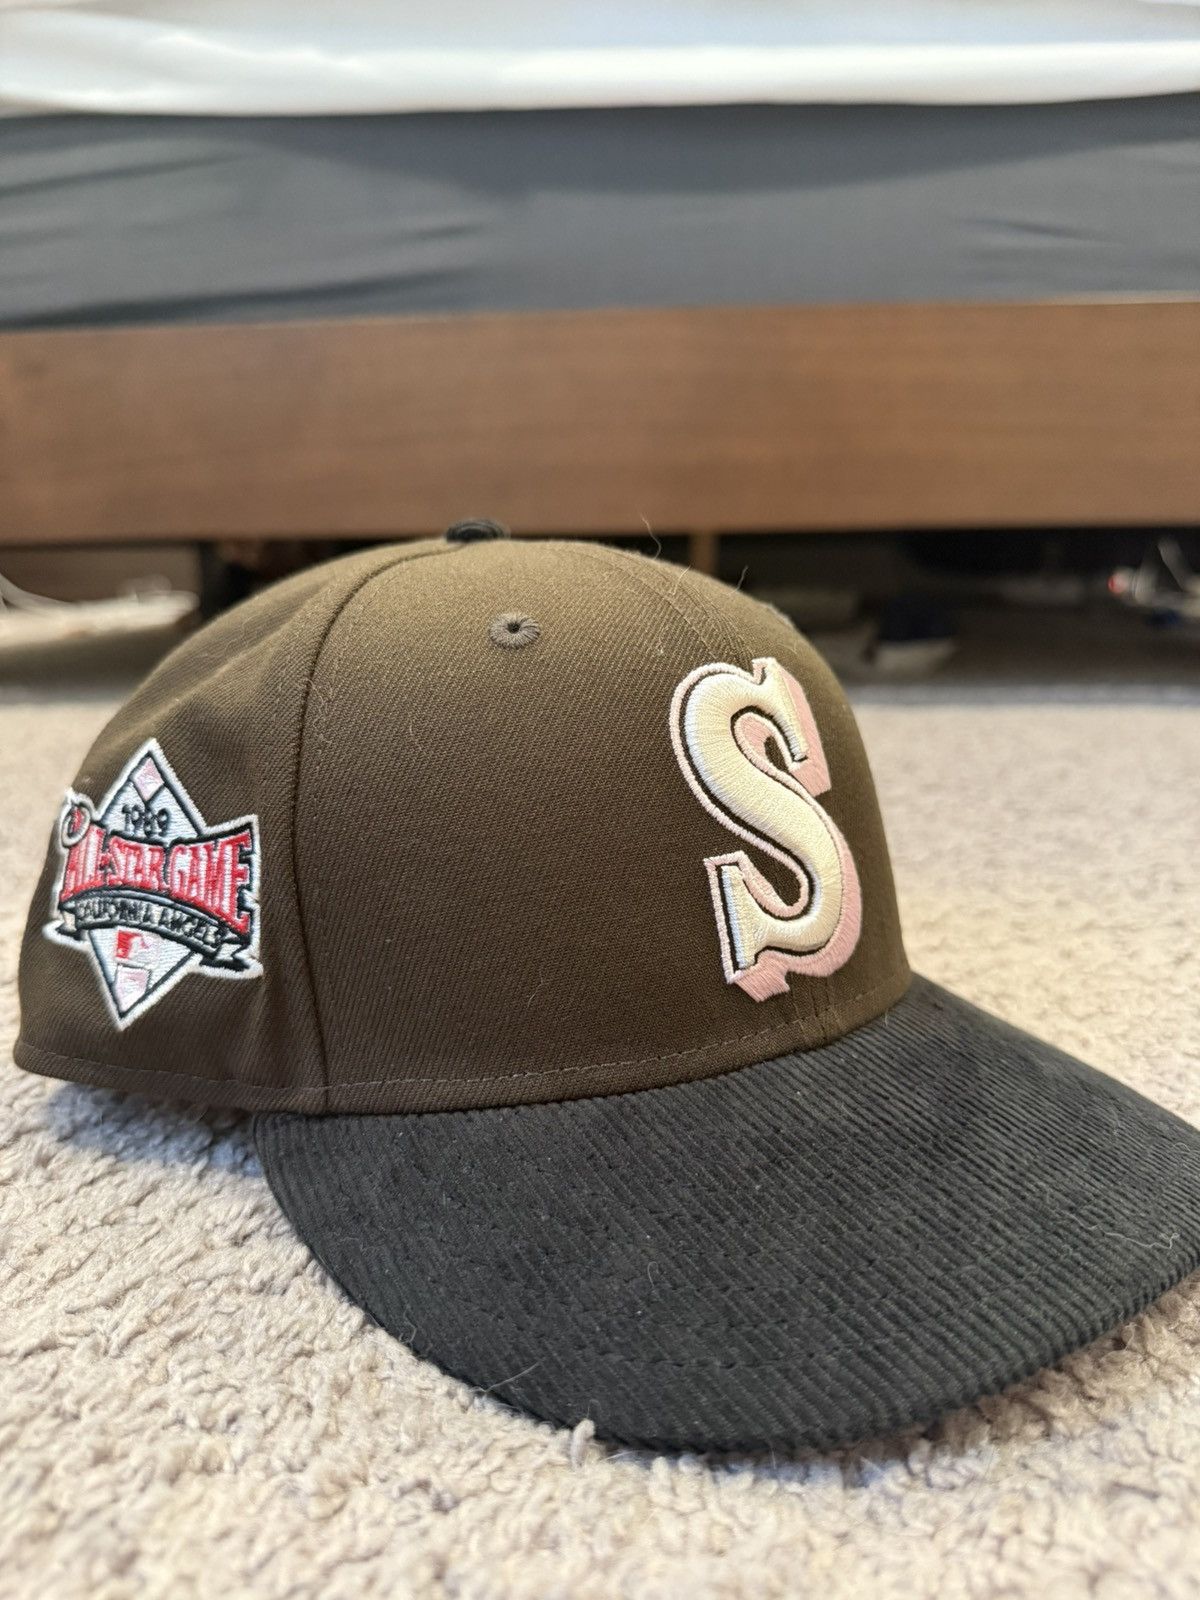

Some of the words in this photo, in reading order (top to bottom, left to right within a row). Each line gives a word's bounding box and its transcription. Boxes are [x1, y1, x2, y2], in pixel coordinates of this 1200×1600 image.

[122, 804, 170, 837] 1989
[669, 657, 862, 1003] S
[168, 831, 251, 936] GAME
